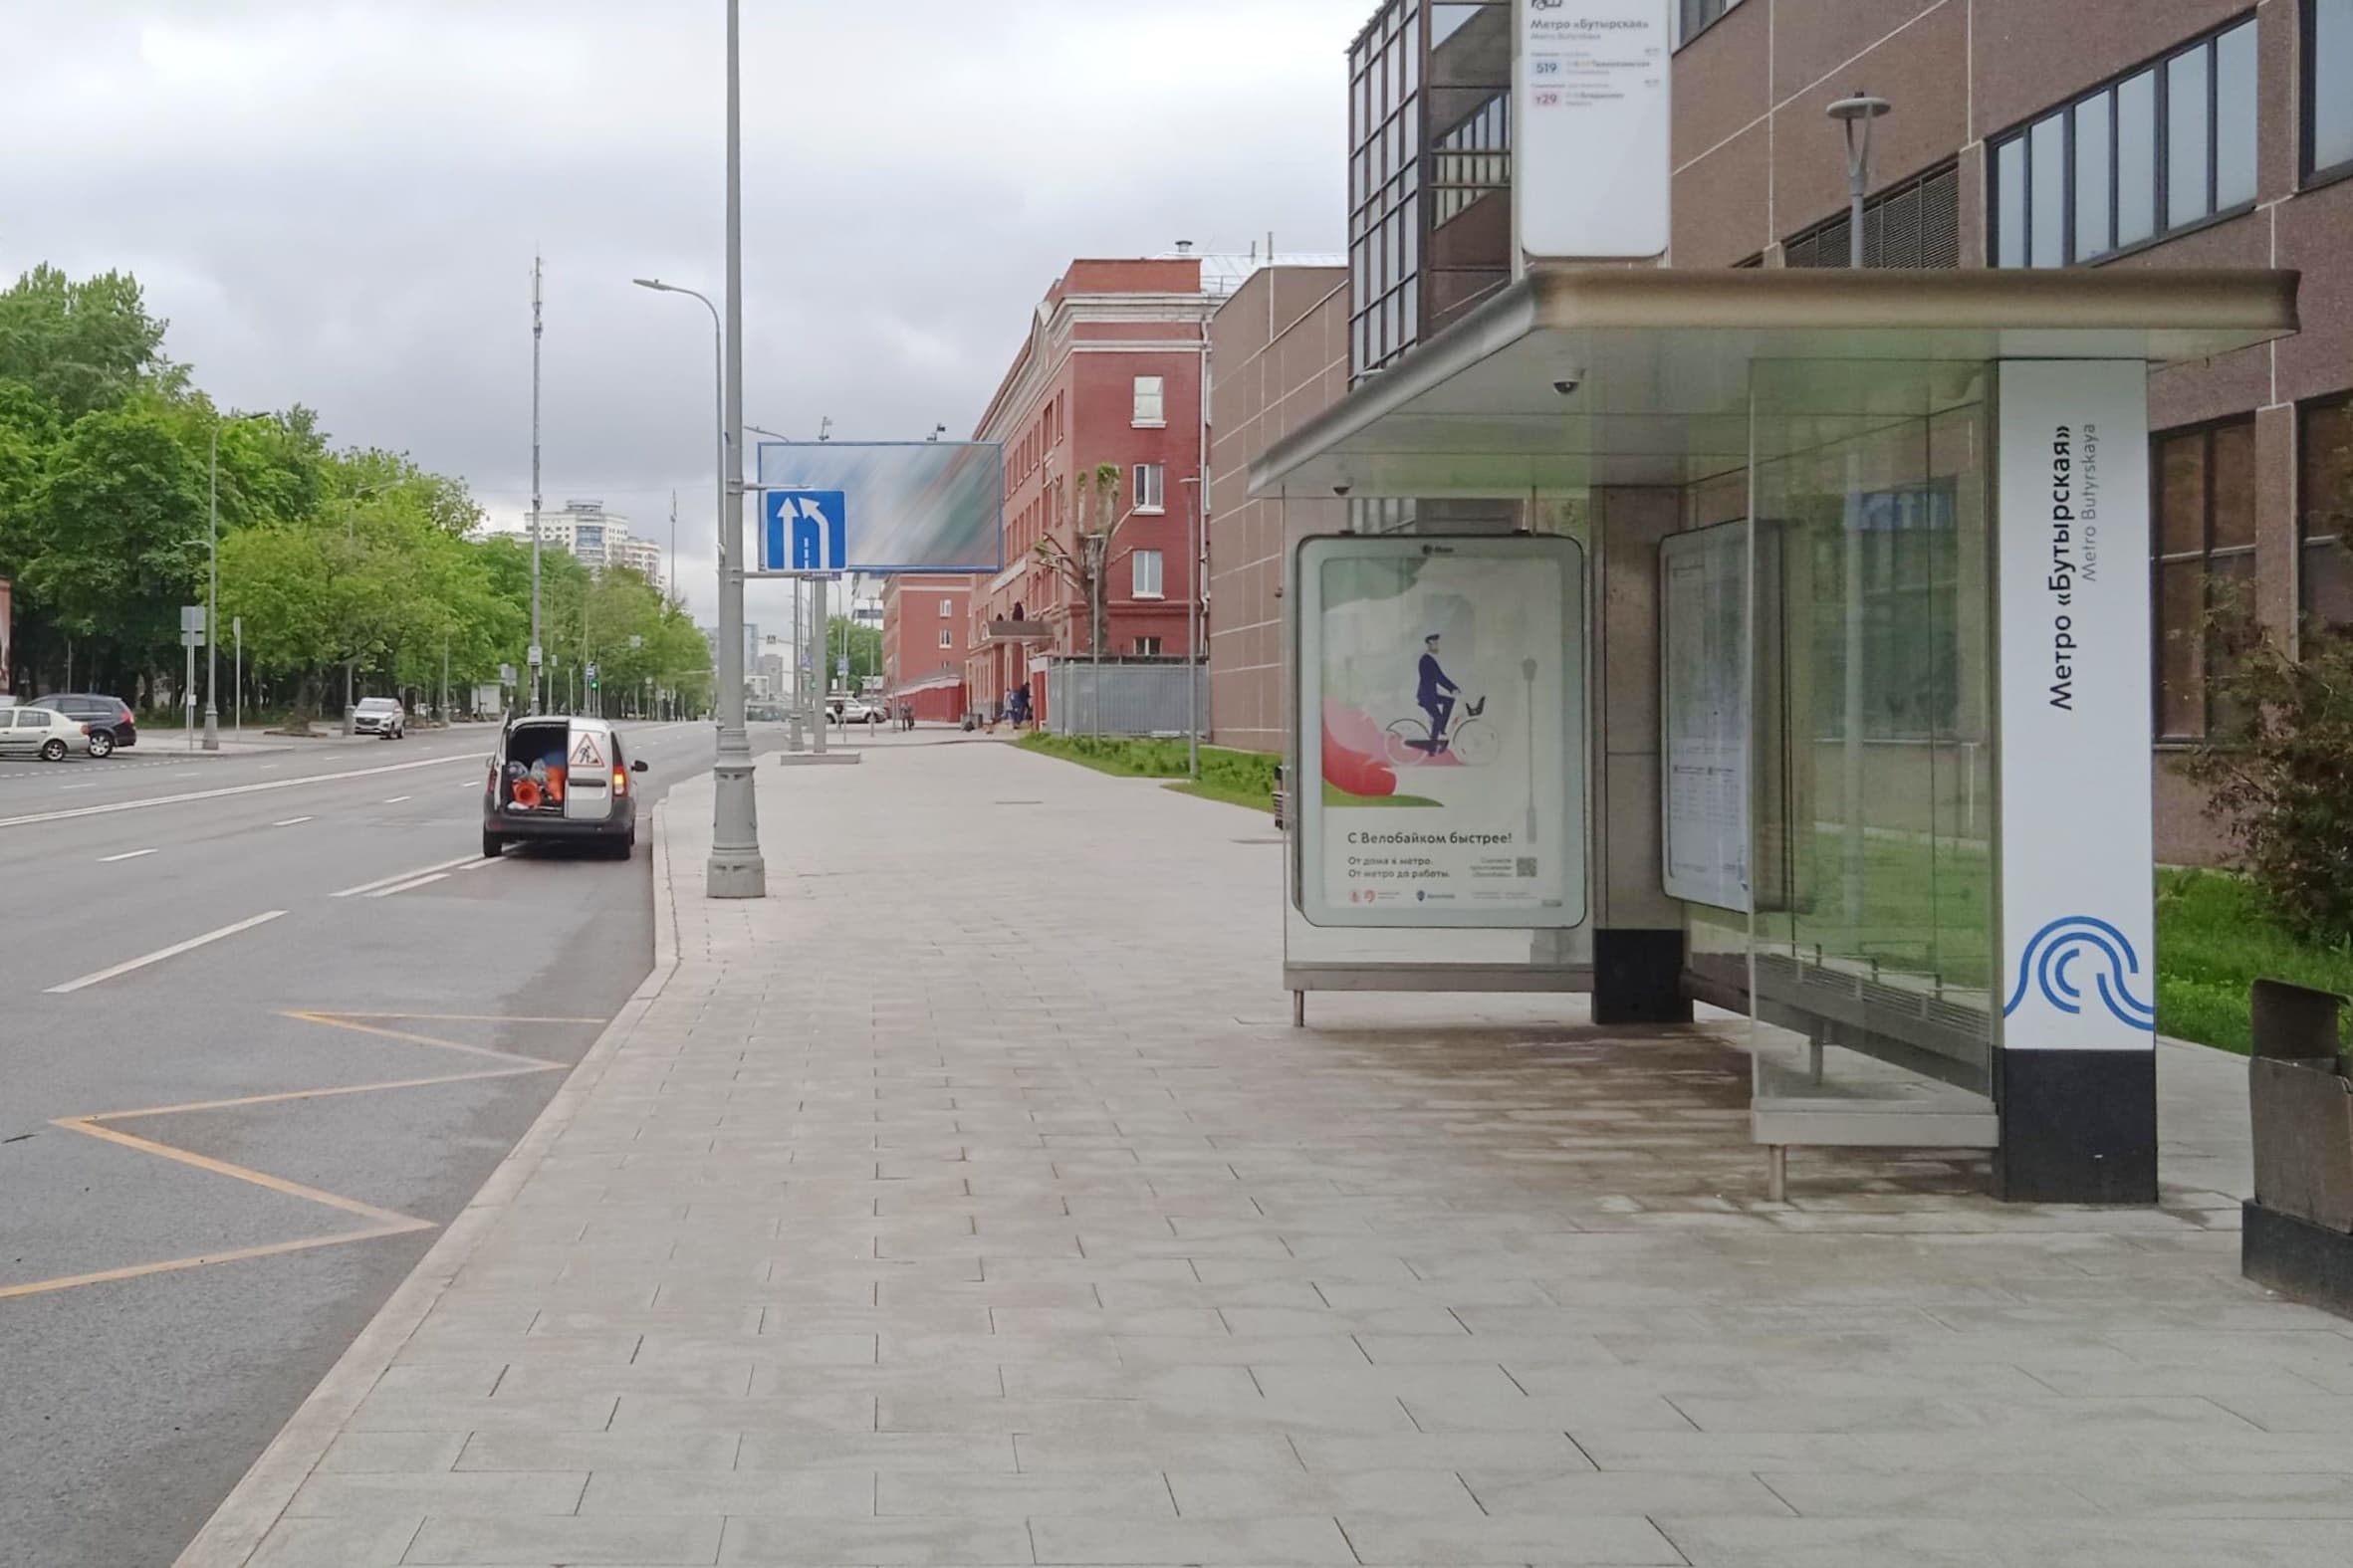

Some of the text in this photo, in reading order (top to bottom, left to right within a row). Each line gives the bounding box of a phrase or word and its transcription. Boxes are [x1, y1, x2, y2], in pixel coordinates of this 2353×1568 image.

[1530, 18, 1649, 31] Метро «Бутырская»
[1536, 63, 1557, 74] 519
[2080, 423, 2099, 581] Metro Butyrskaya
[2048, 425, 2077, 711] Метро «Бутырская»
[1347, 831, 1513, 846] С Велобайком быстрее!
[1348, 856, 1361, 865] От
[1363, 857, 1389, 866] дома
[1400, 857, 1433, 866] метро.
[1348, 868, 1450, 879] От метро до работы.
